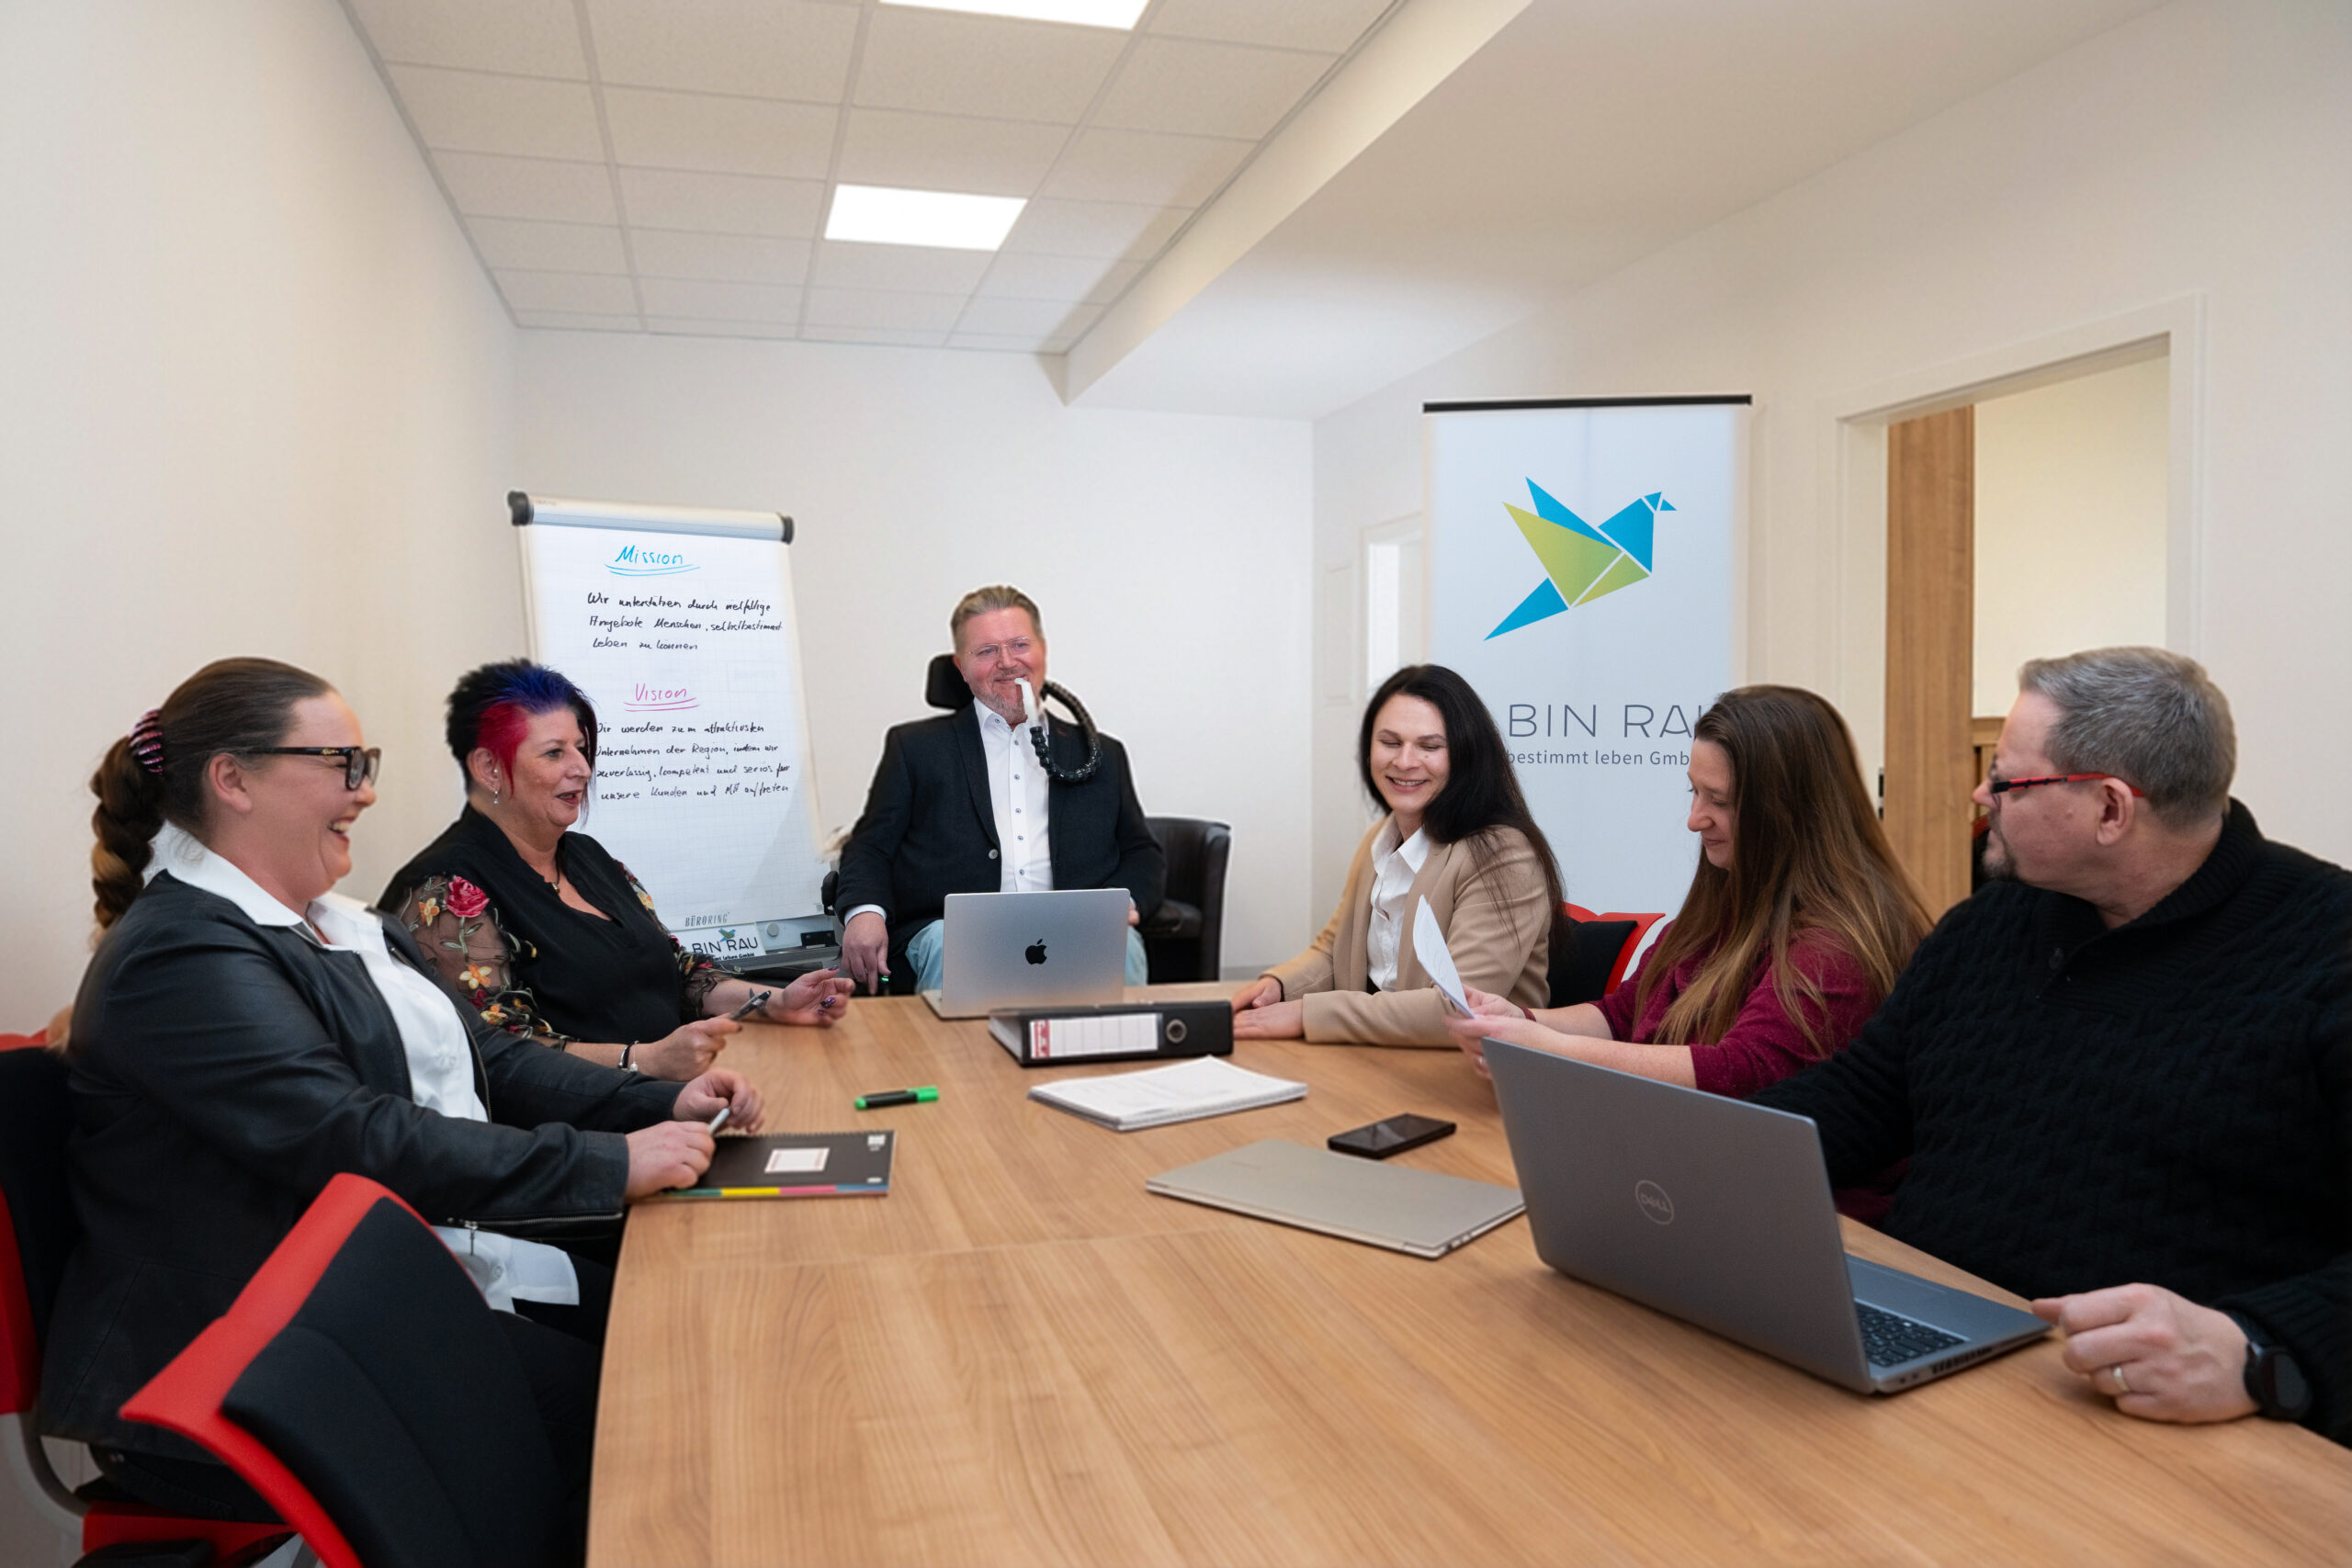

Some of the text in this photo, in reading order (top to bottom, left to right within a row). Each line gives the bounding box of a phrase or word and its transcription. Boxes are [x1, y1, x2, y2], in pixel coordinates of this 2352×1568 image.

[615, 545, 683, 565] Mission
[587, 592, 609, 604] Wir
[687, 599, 718, 610] durch
[589, 615, 643, 632] Angebote
[635, 683, 687, 702] Vision
[621, 722, 663, 733] werden
[1509, 704, 1702, 739] BIN RA
[666, 745, 686, 754] der
[692, 743, 728, 760] Region,
[1595, 750, 1643, 764] leben
[717, 765, 738, 773] und
[601, 792, 640, 800] unsere
[650, 786, 687, 797] Kunden
[696, 784, 717, 796] und
[685, 913, 728, 927] BÜRORING
[692, 936, 758, 954] BIN RAU
